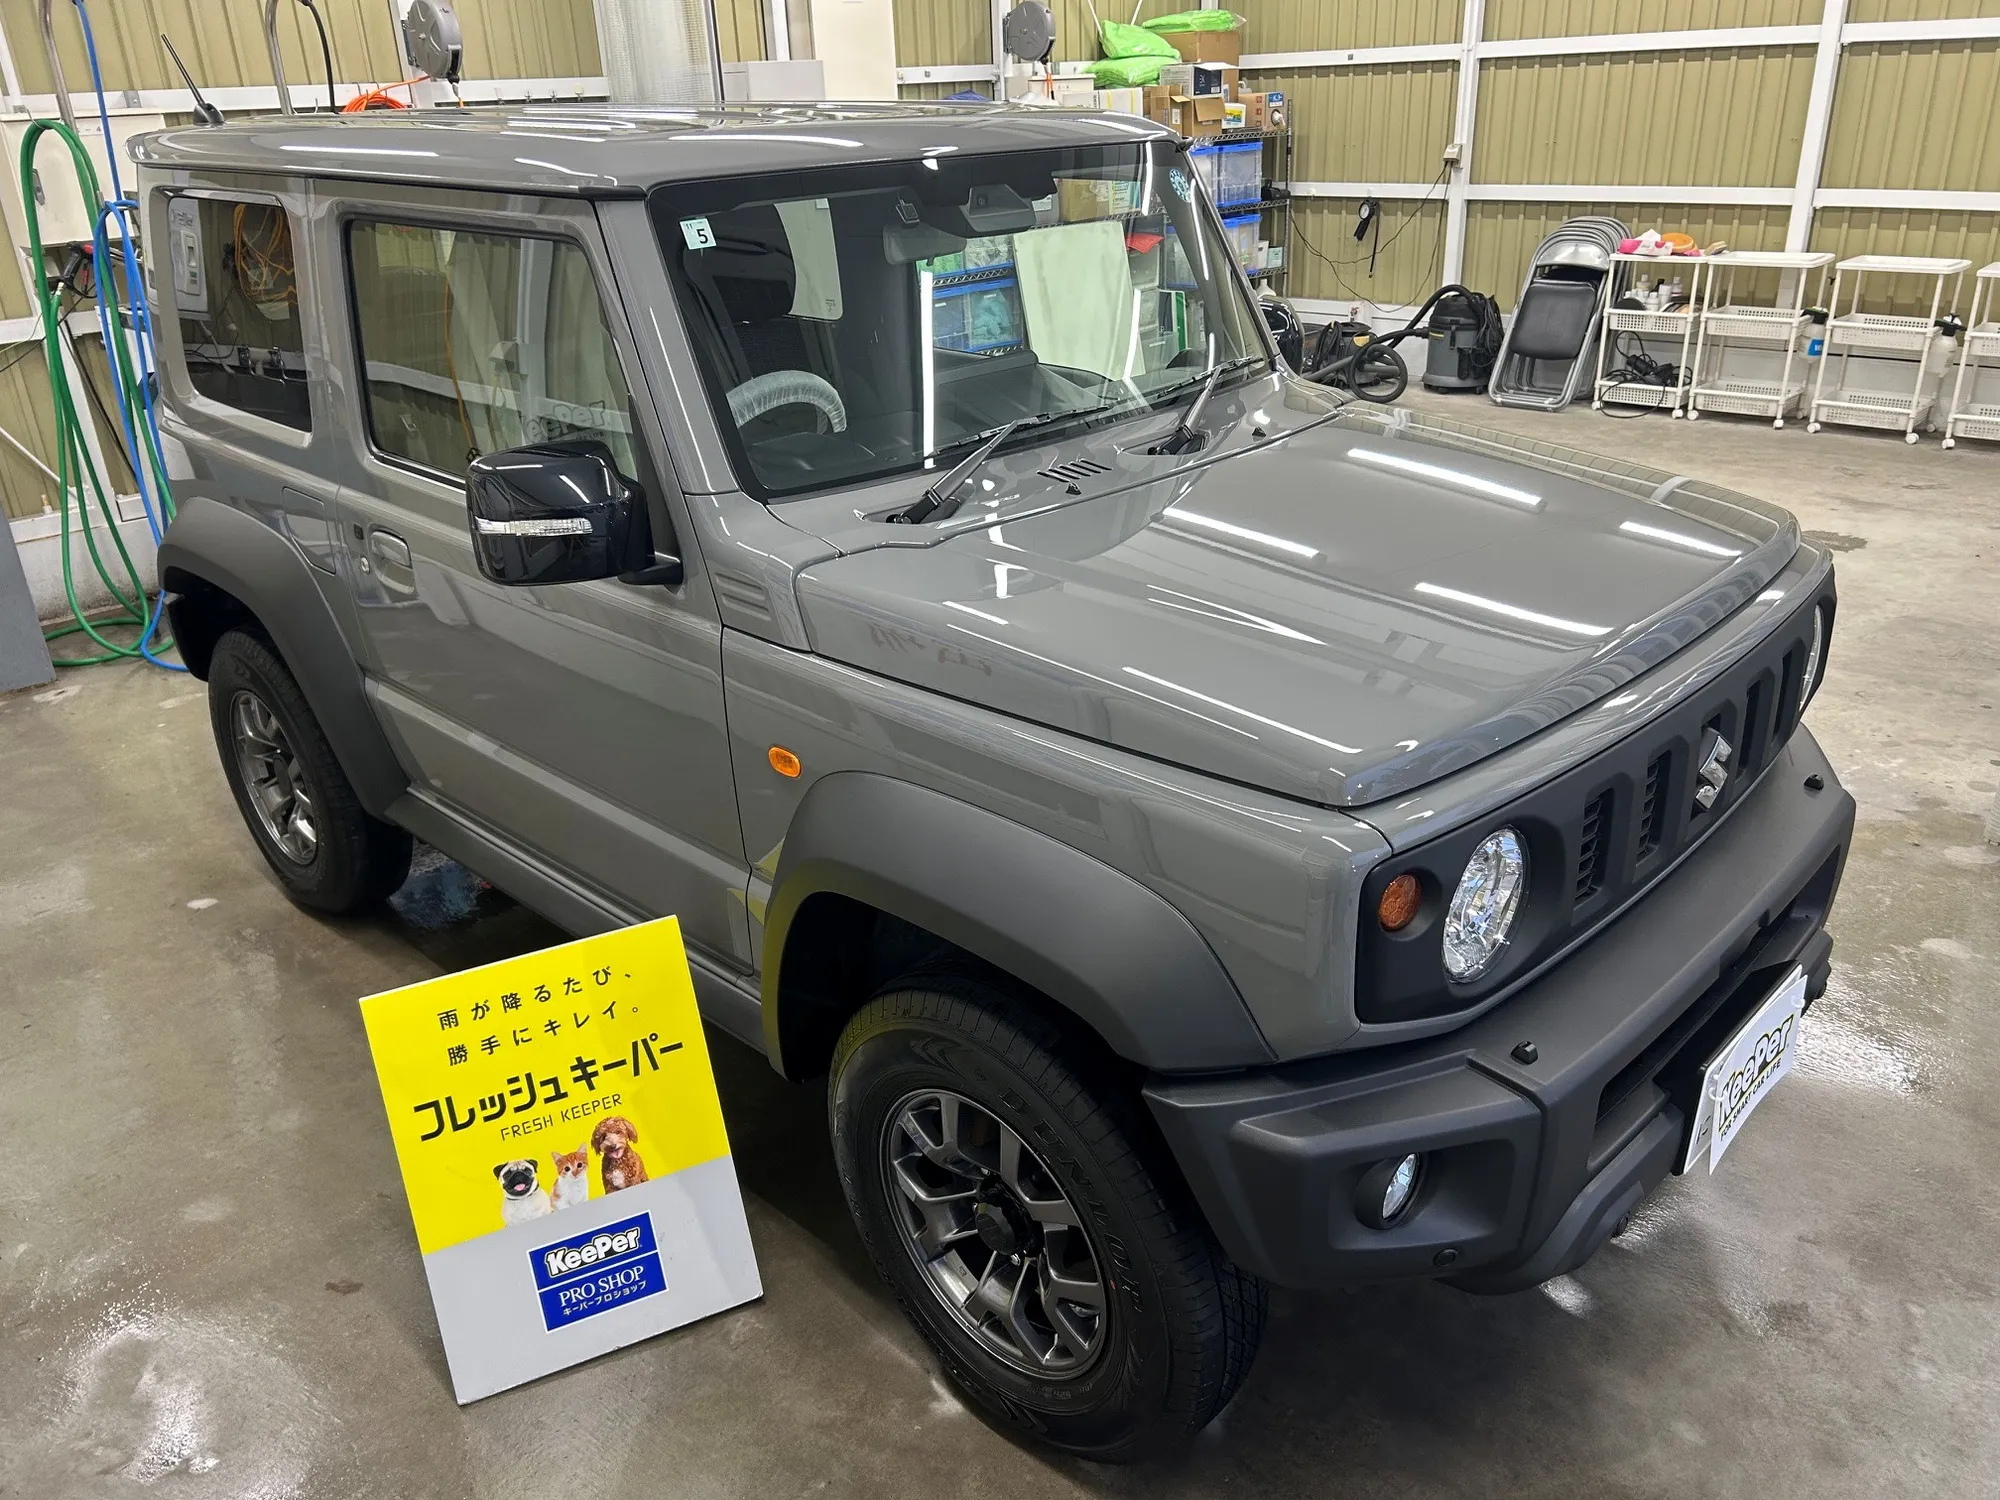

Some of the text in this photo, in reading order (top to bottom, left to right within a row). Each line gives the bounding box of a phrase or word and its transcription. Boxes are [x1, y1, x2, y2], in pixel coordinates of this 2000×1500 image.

[696, 228, 709, 244] 5
[437, 966, 631, 1031] 雨が降るたび、
[447, 1001, 639, 1066] 勝手にキレイ。
[413, 1032, 684, 1142] フレッシュキーパー
[1752, 1077, 1765, 1099] CAR
[1765, 1059, 1781, 1081] LIFE
[500, 1093, 623, 1141] FRESH KEEPER
[545, 1227, 641, 1278] KeePer
[558, 1265, 645, 1308] PRO SHOP
